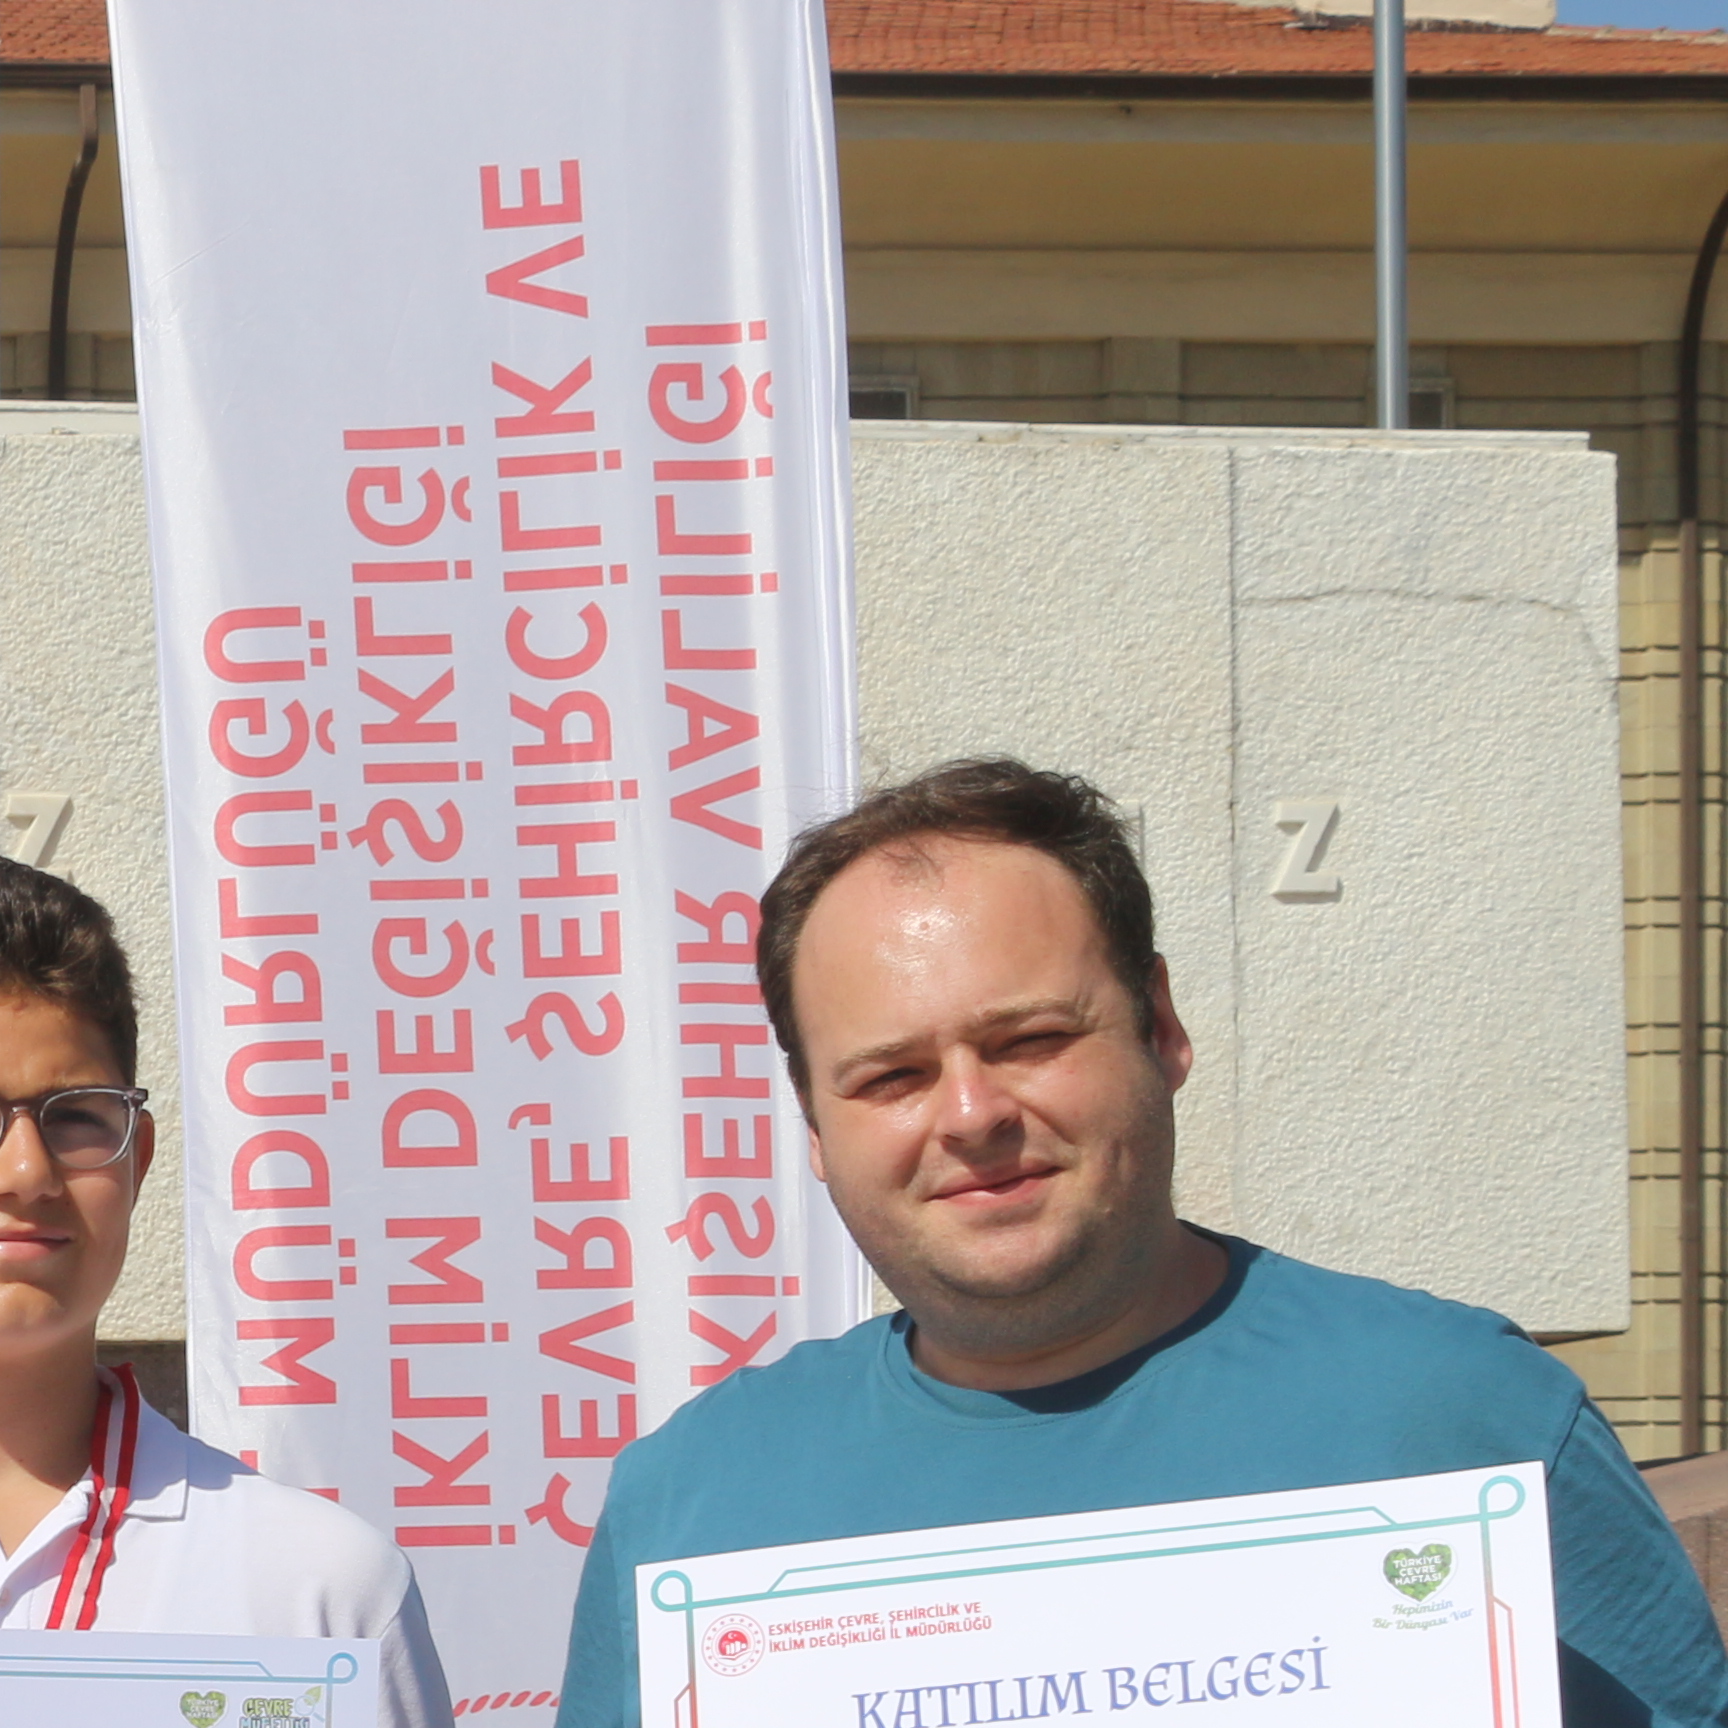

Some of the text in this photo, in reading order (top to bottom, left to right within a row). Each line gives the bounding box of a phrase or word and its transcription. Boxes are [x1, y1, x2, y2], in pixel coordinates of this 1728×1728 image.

[1393, 1555, 1442, 1568] TÜRKİYE
[1400, 1565, 1437, 1577] ÇEVRE
[1394, 1574, 1442, 1586] HAFTASI
[767, 1601, 981, 1636] ESKİŞEHİR ÇEVRE, ŞEHİRCİLİK VE
[768, 1616, 992, 1652] İKLİM DEĞİŞİKLİĞİ İL MÜDÜRLÜĞÜ
[1101, 1635, 1330, 1710] BELGESİ
